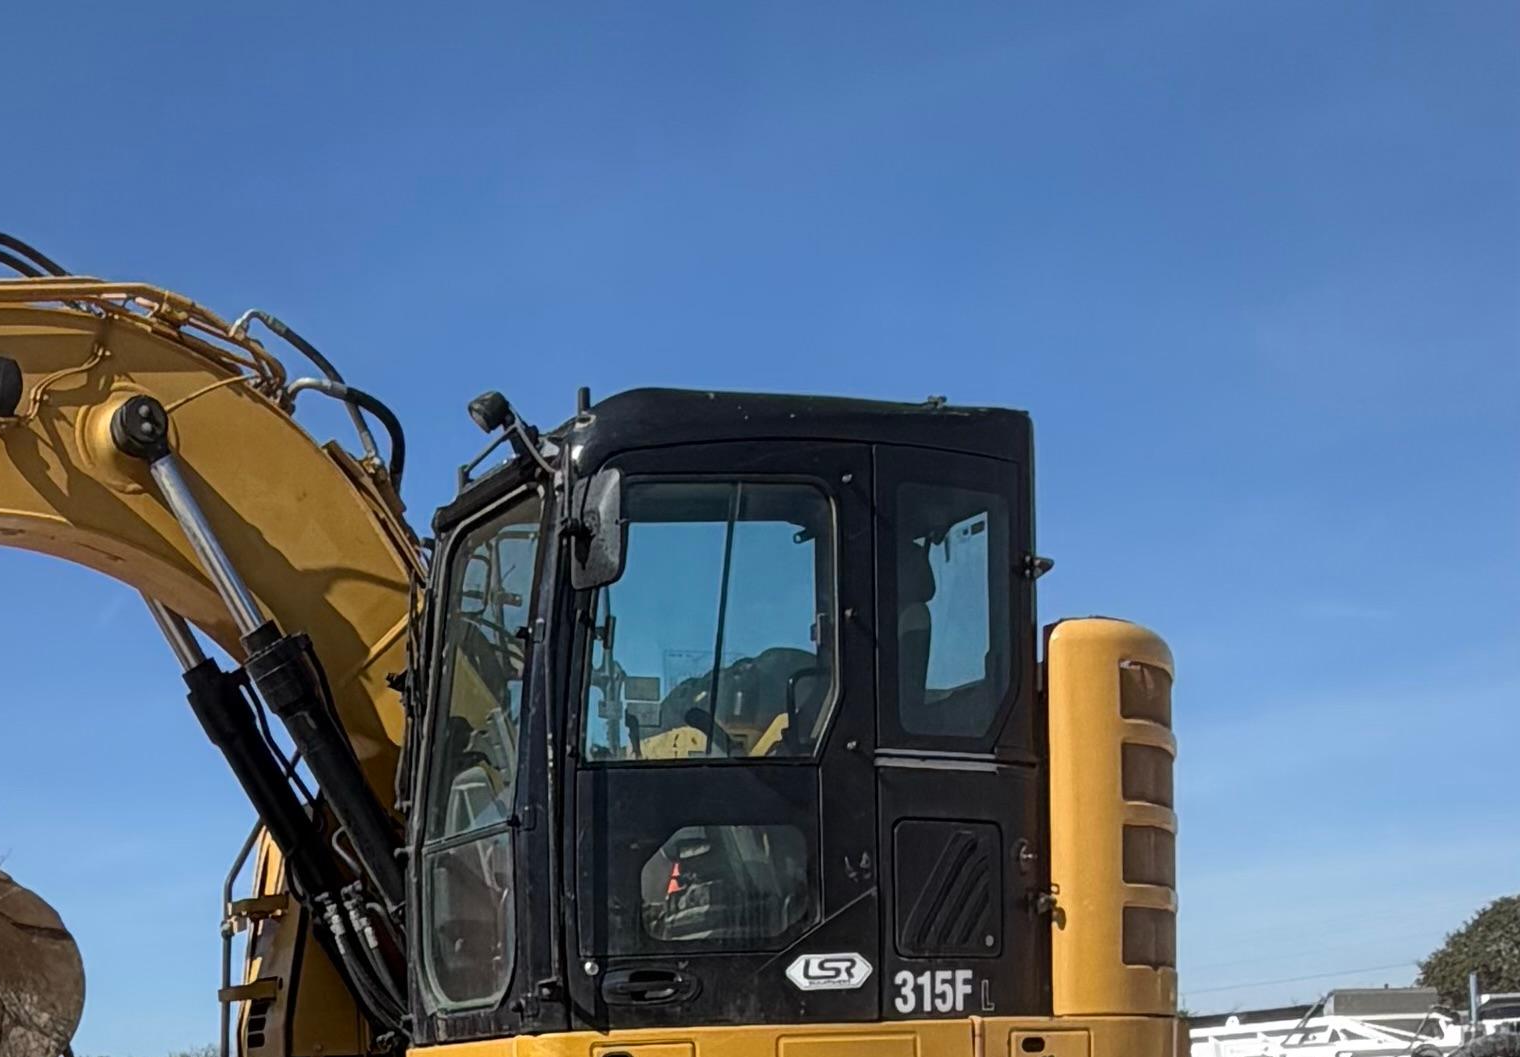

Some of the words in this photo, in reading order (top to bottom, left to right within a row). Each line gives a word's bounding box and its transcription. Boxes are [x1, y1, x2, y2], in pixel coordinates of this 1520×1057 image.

[803, 957, 856, 980] LSR
[894, 969, 973, 1013] 315F
[981, 979, 995, 1011] L
